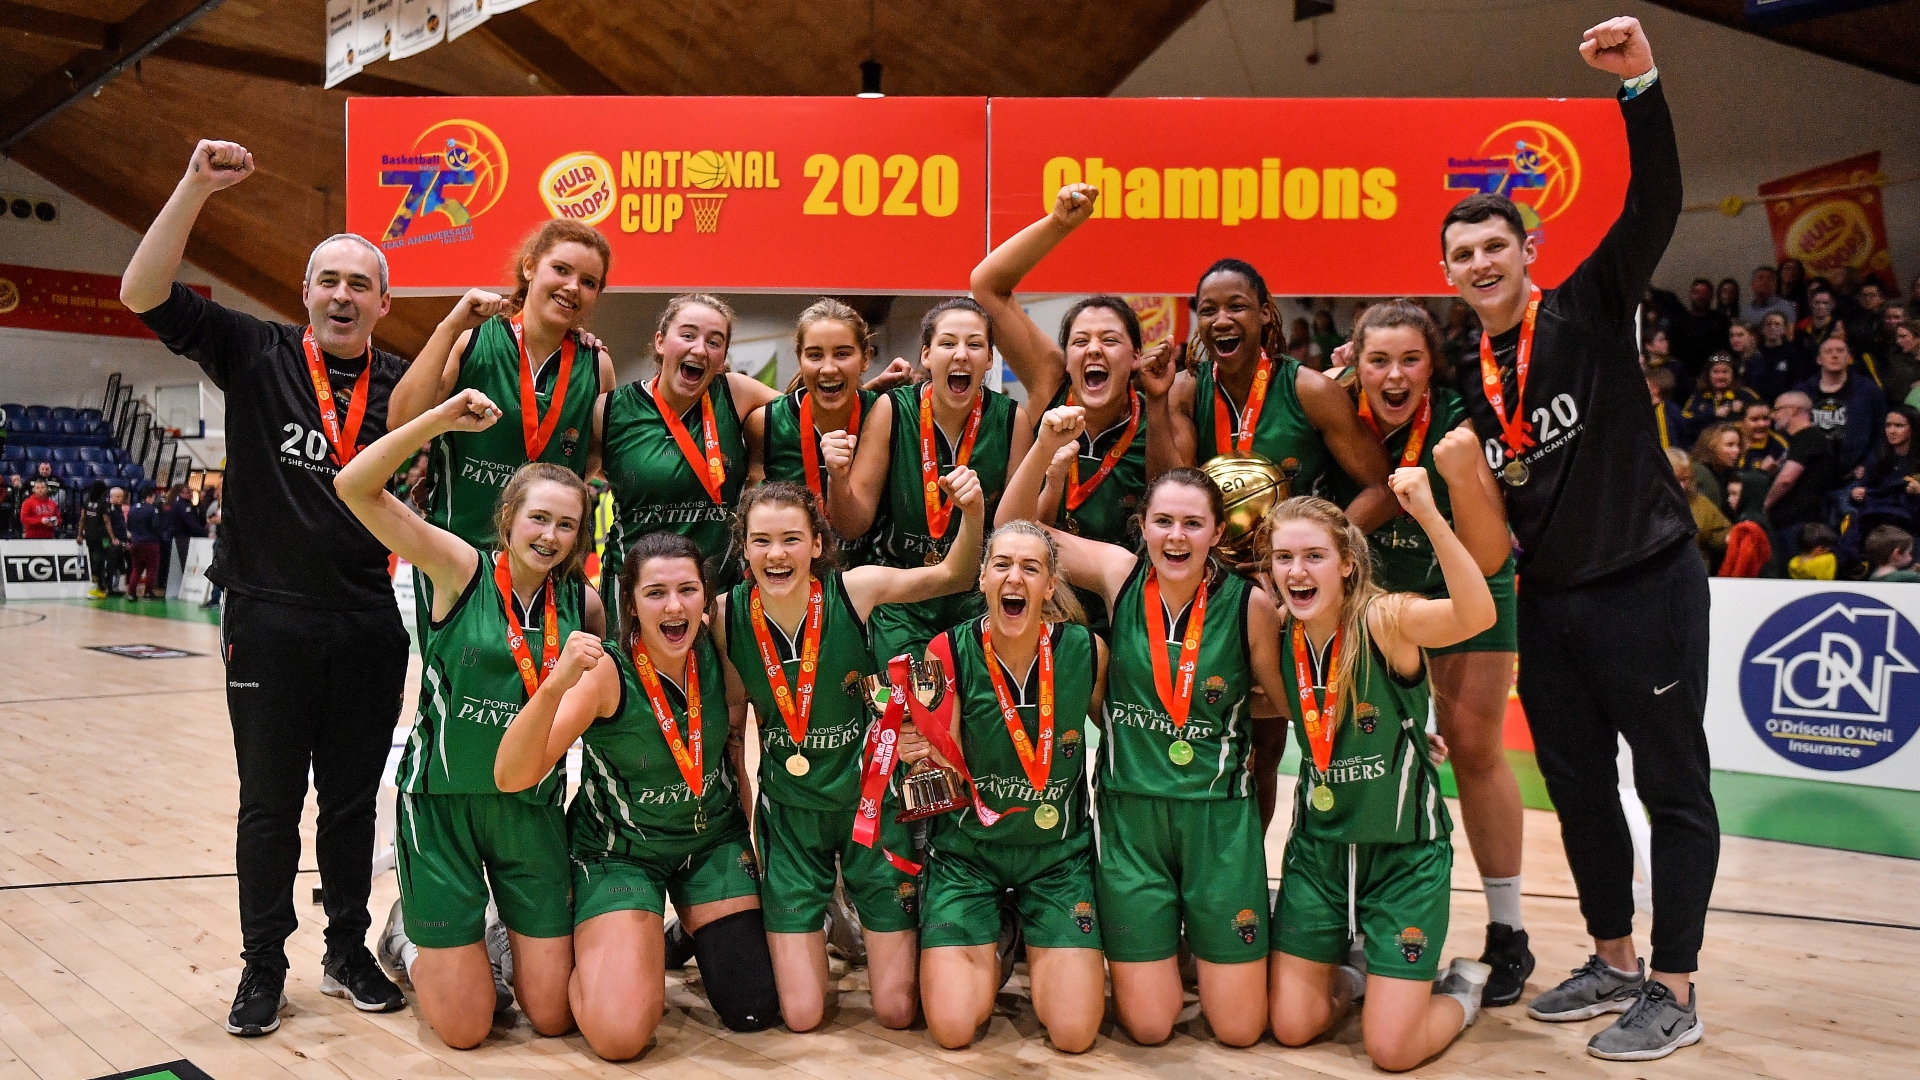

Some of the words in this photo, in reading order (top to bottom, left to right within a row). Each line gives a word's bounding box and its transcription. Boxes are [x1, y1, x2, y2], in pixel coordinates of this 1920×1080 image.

[553, 165, 597, 199] HULA
[802, 153, 960, 218] 2020
[1042, 156, 1398, 226] Champions
[557, 181, 610, 220] HOOPS
[620, 193, 684, 233] CUP
[381, 240, 405, 251] YEAR
[280, 422, 328, 460] 20
[288, 458, 303, 467] SHE
[304, 462, 330, 474] CAN'T
[461, 463, 515, 488] PANT
[480, 460, 516, 473] PORTL
[632, 507, 729, 523] PANTHERS
[457, 703, 518, 728] PANT
[482, 699, 523, 711] PORTL
[1127, 703, 1192, 724] PORTLAOE
[767, 722, 860, 749] PANTHERS
[780, 725, 844, 735] POLAOISE
[1112, 708, 1213, 740] PANTHERS
[1765, 718, 1841, 738] O'Driscoll
[1843, 725, 1894, 743] O'Neil
[1788, 739, 1862, 758] Insurance
[1309, 756, 1362, 767] PLAOISE
[974, 782, 1068, 801] PANTHERS
[990, 774, 1053, 786] PORTLAOE
